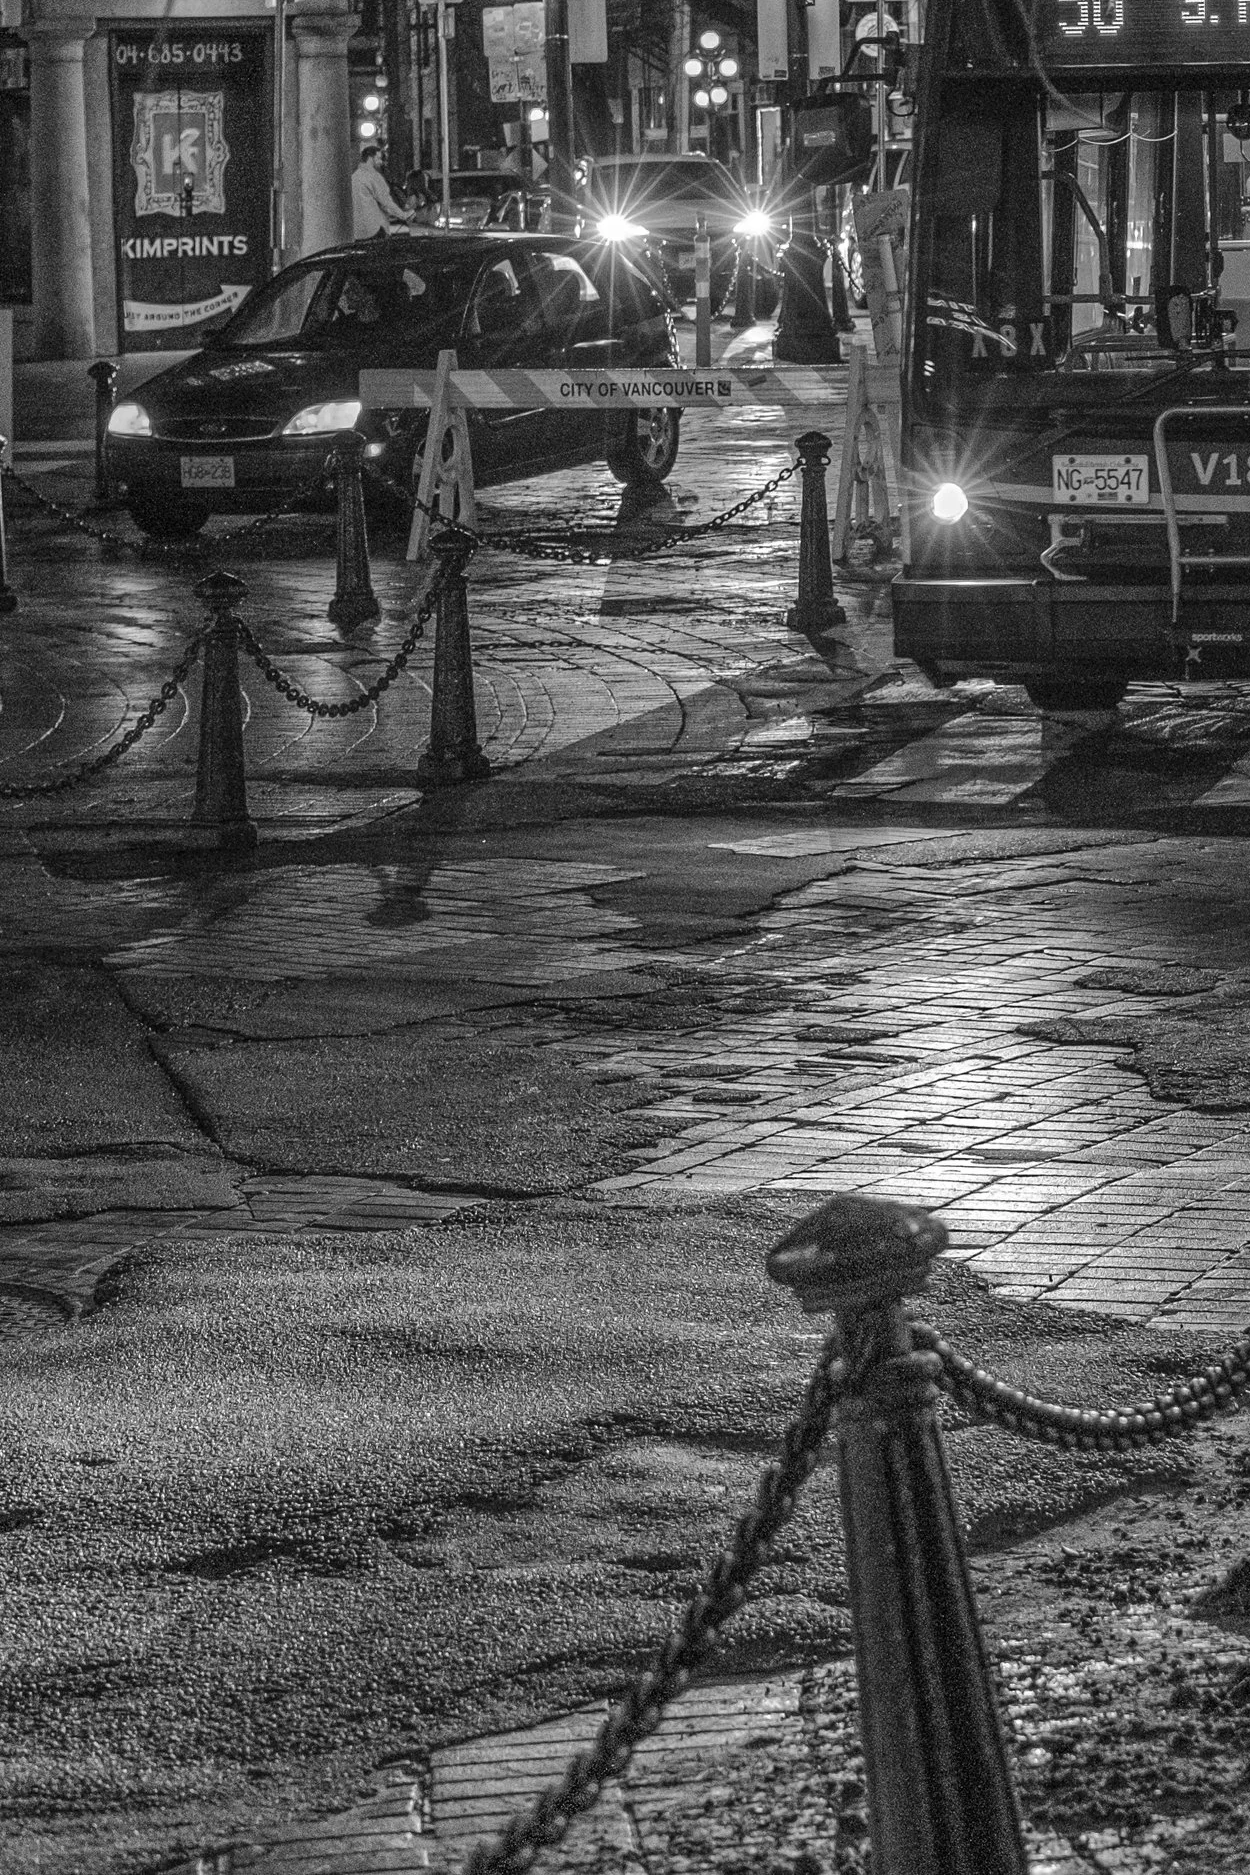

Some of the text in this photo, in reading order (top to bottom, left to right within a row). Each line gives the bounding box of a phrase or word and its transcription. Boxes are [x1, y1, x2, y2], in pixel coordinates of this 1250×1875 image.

[161, 128, 200, 175] K
[121, 235, 248, 259] KIMPRINTS
[143, 312, 180, 321] AROUND
[184, 307, 202, 318] THE
[204, 291, 239, 313] CORNER
[560, 381, 715, 397] CITY OF VANCOUVER
